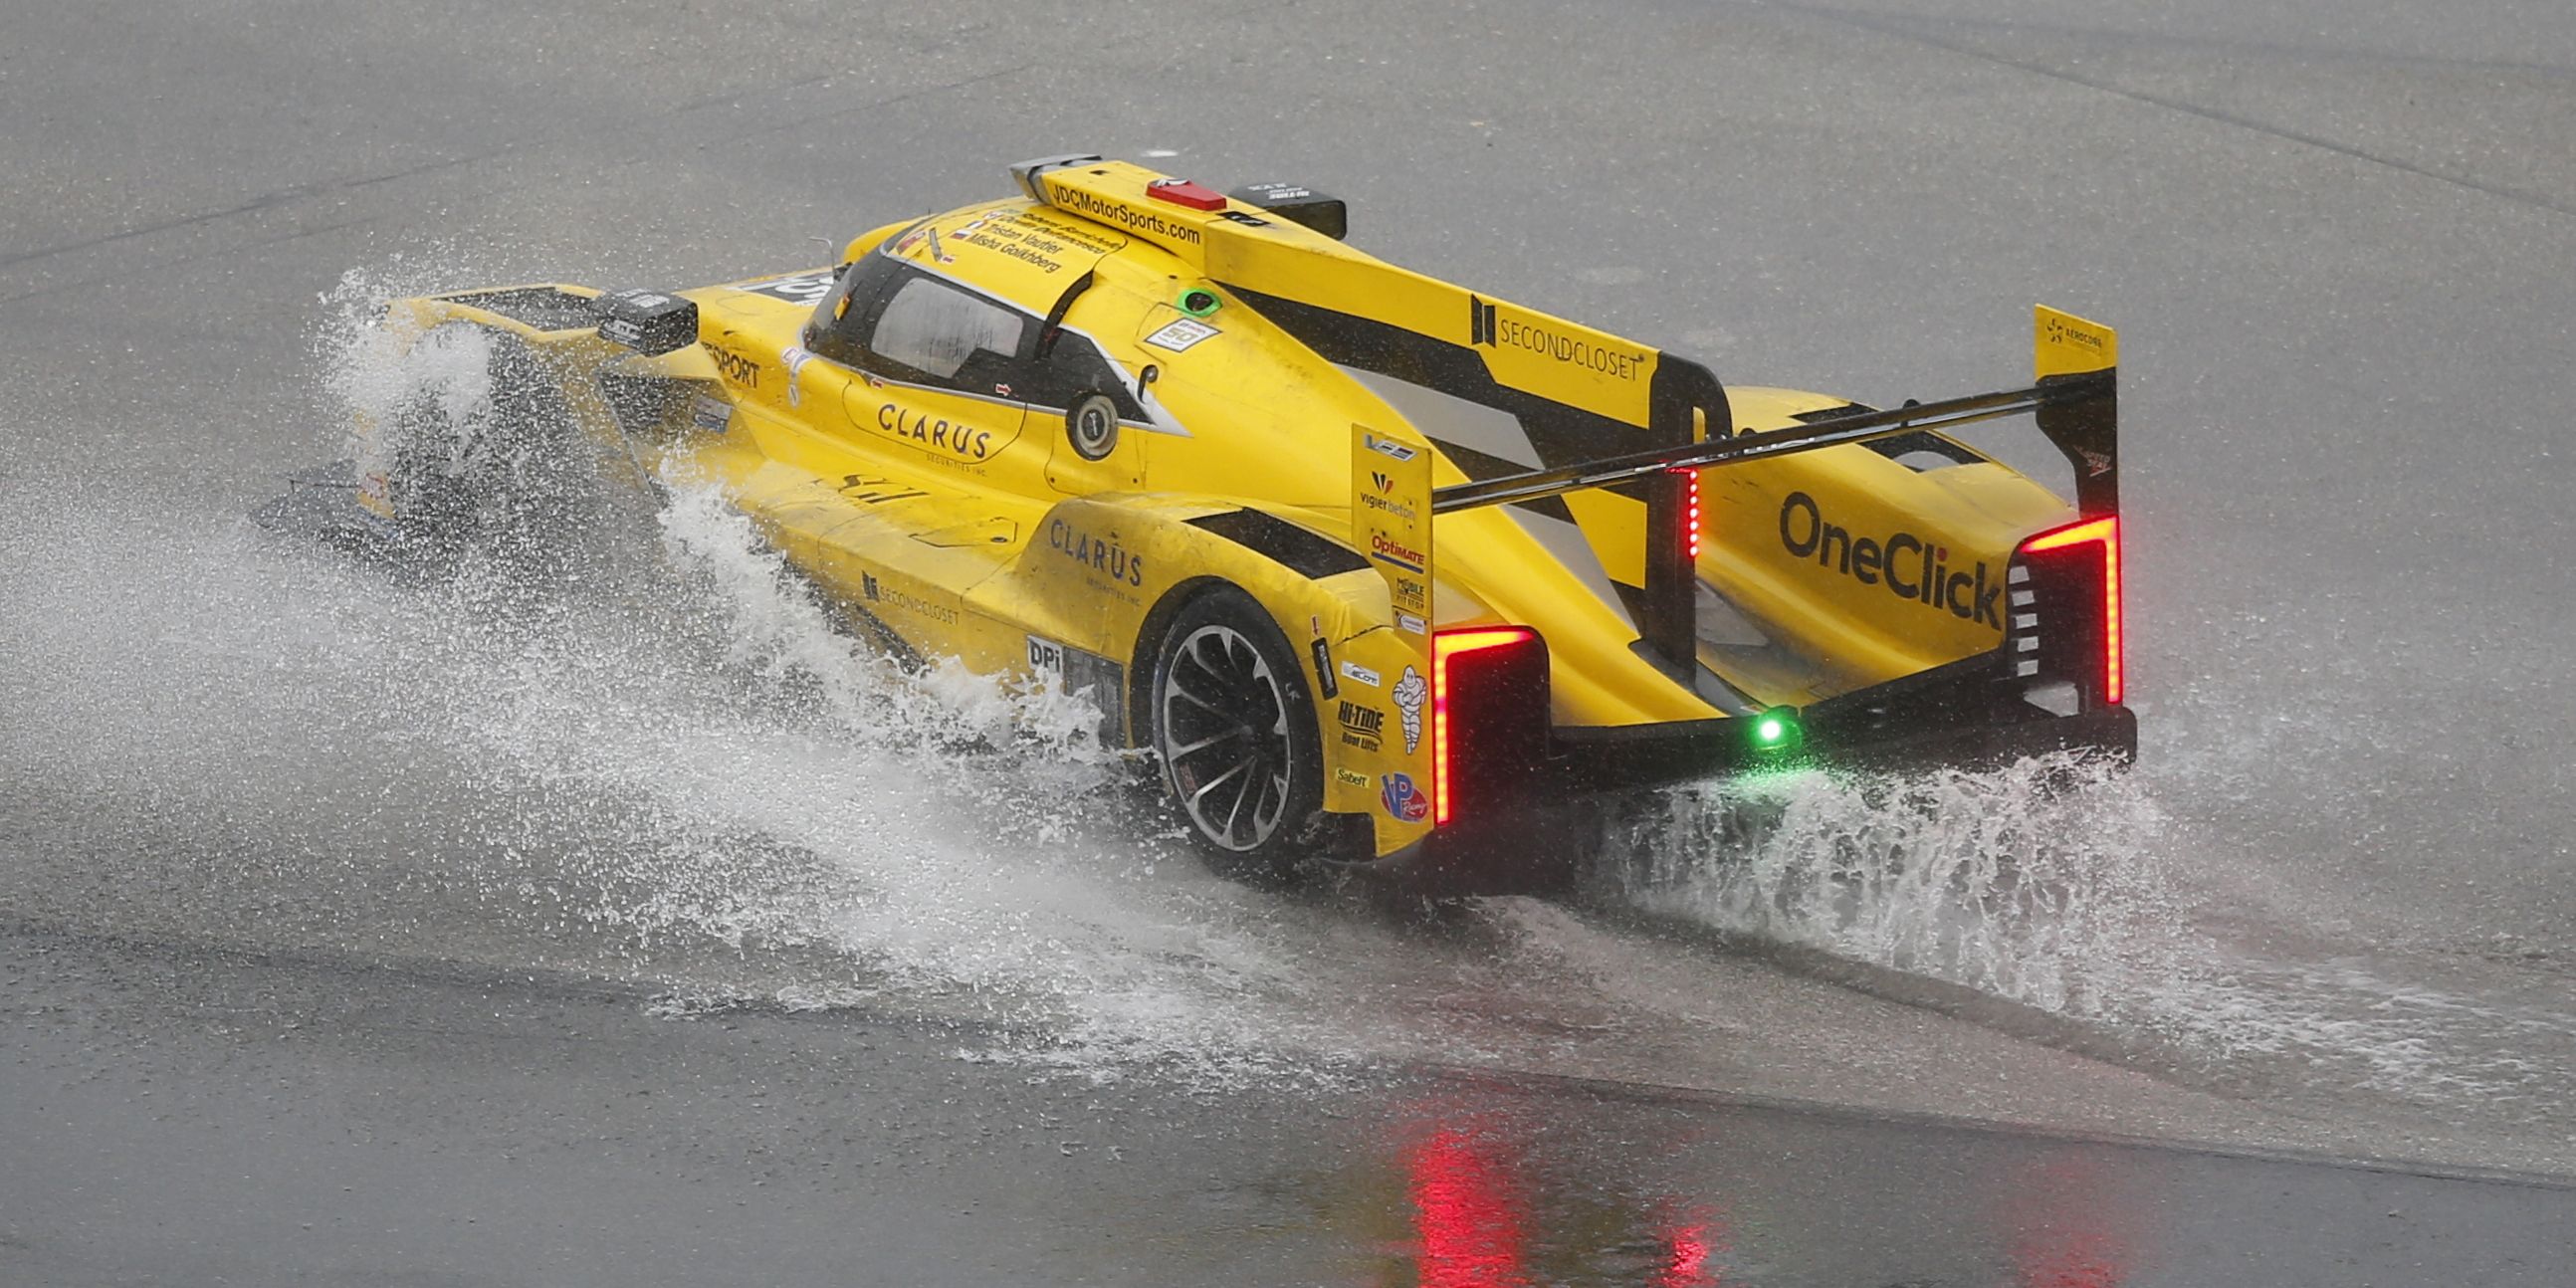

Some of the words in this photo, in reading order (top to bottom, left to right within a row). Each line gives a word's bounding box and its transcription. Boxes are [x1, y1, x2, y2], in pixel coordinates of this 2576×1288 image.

[1053, 184, 1200, 244] JDCMotorSports.com
[967, 233, 1002, 250] Misha
[999, 243, 1062, 274] Goikhberg
[1021, 233, 1064, 256] Vautier
[1500, 318, 1640, 382] SECONDCLOSET
[878, 403, 990, 459] CLARUS
[1050, 519, 1142, 587] CLARUS
[1780, 491, 2002, 631] OneClick
[1029, 640, 1060, 673] DPi
